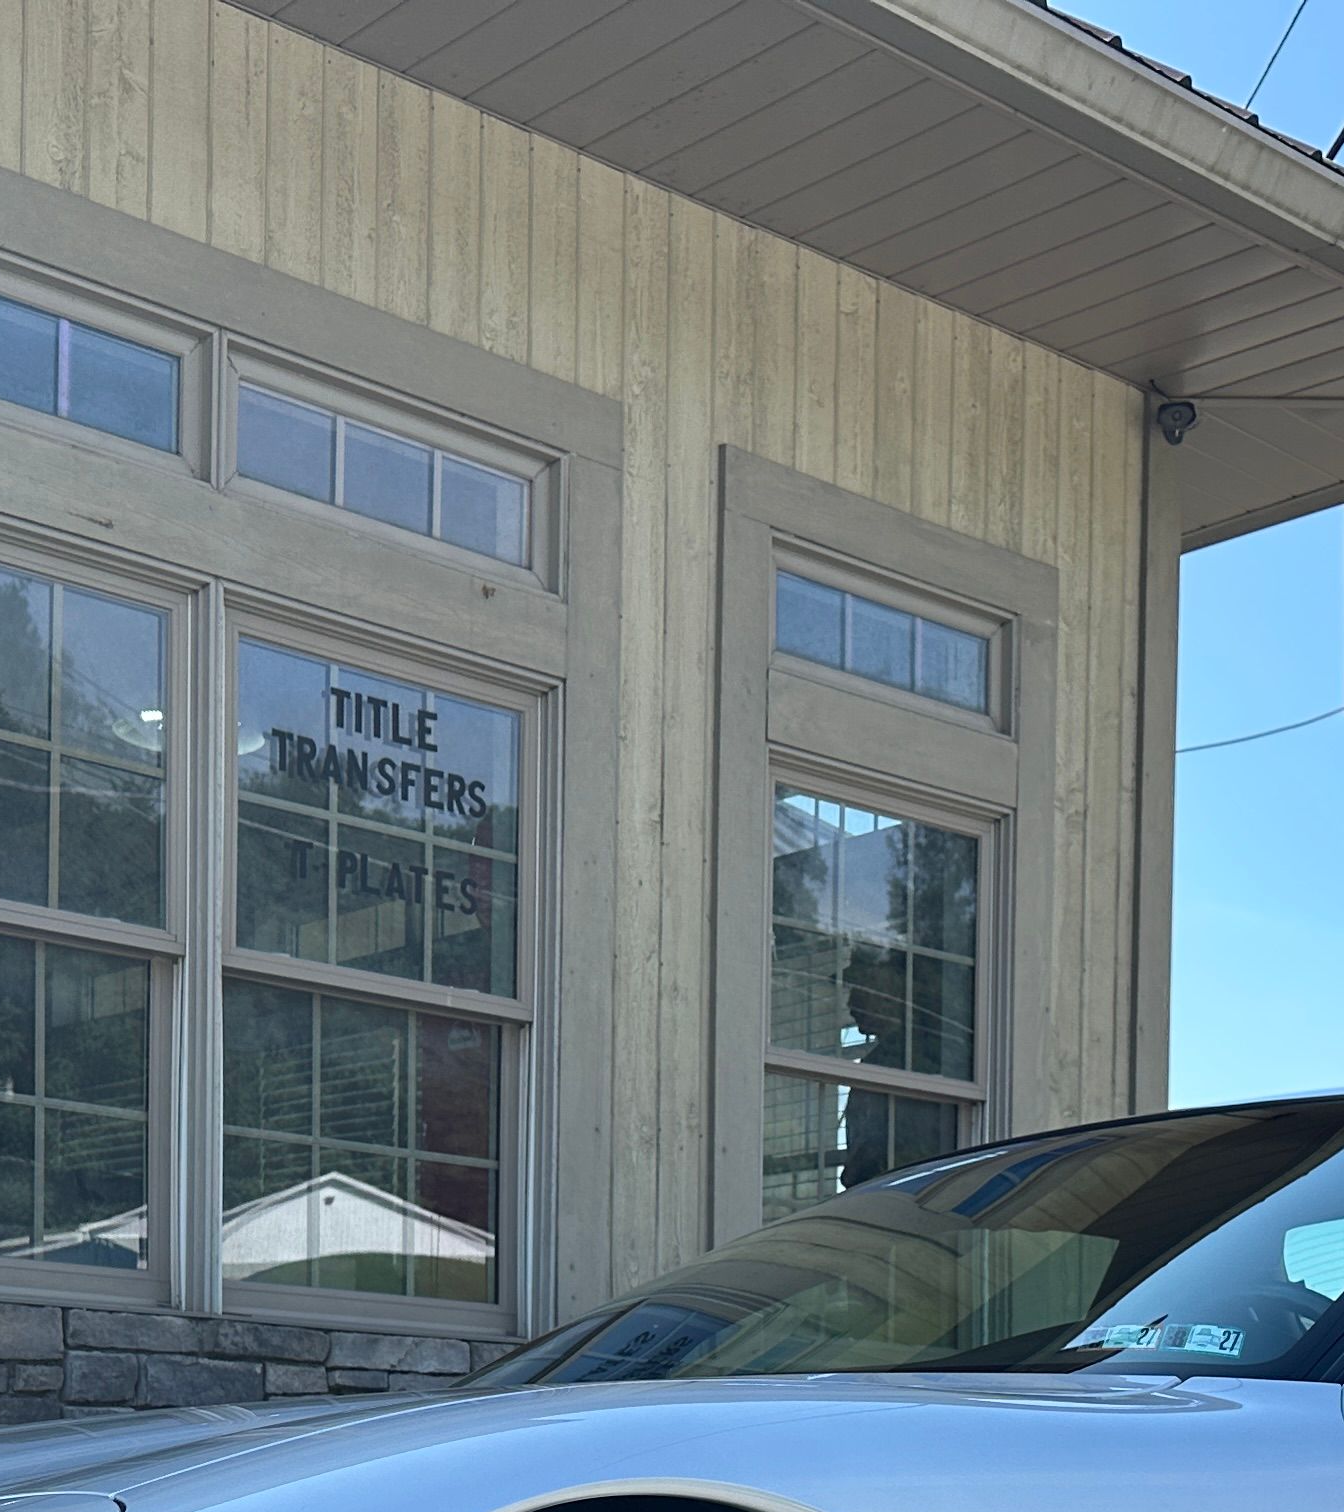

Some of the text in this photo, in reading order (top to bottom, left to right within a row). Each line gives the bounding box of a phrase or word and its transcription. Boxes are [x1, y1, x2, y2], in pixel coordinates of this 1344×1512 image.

[331, 687, 438, 752] TITLE
[271, 727, 487, 819] TRANSFERS
[1218, 1330, 1241, 1351] 27
